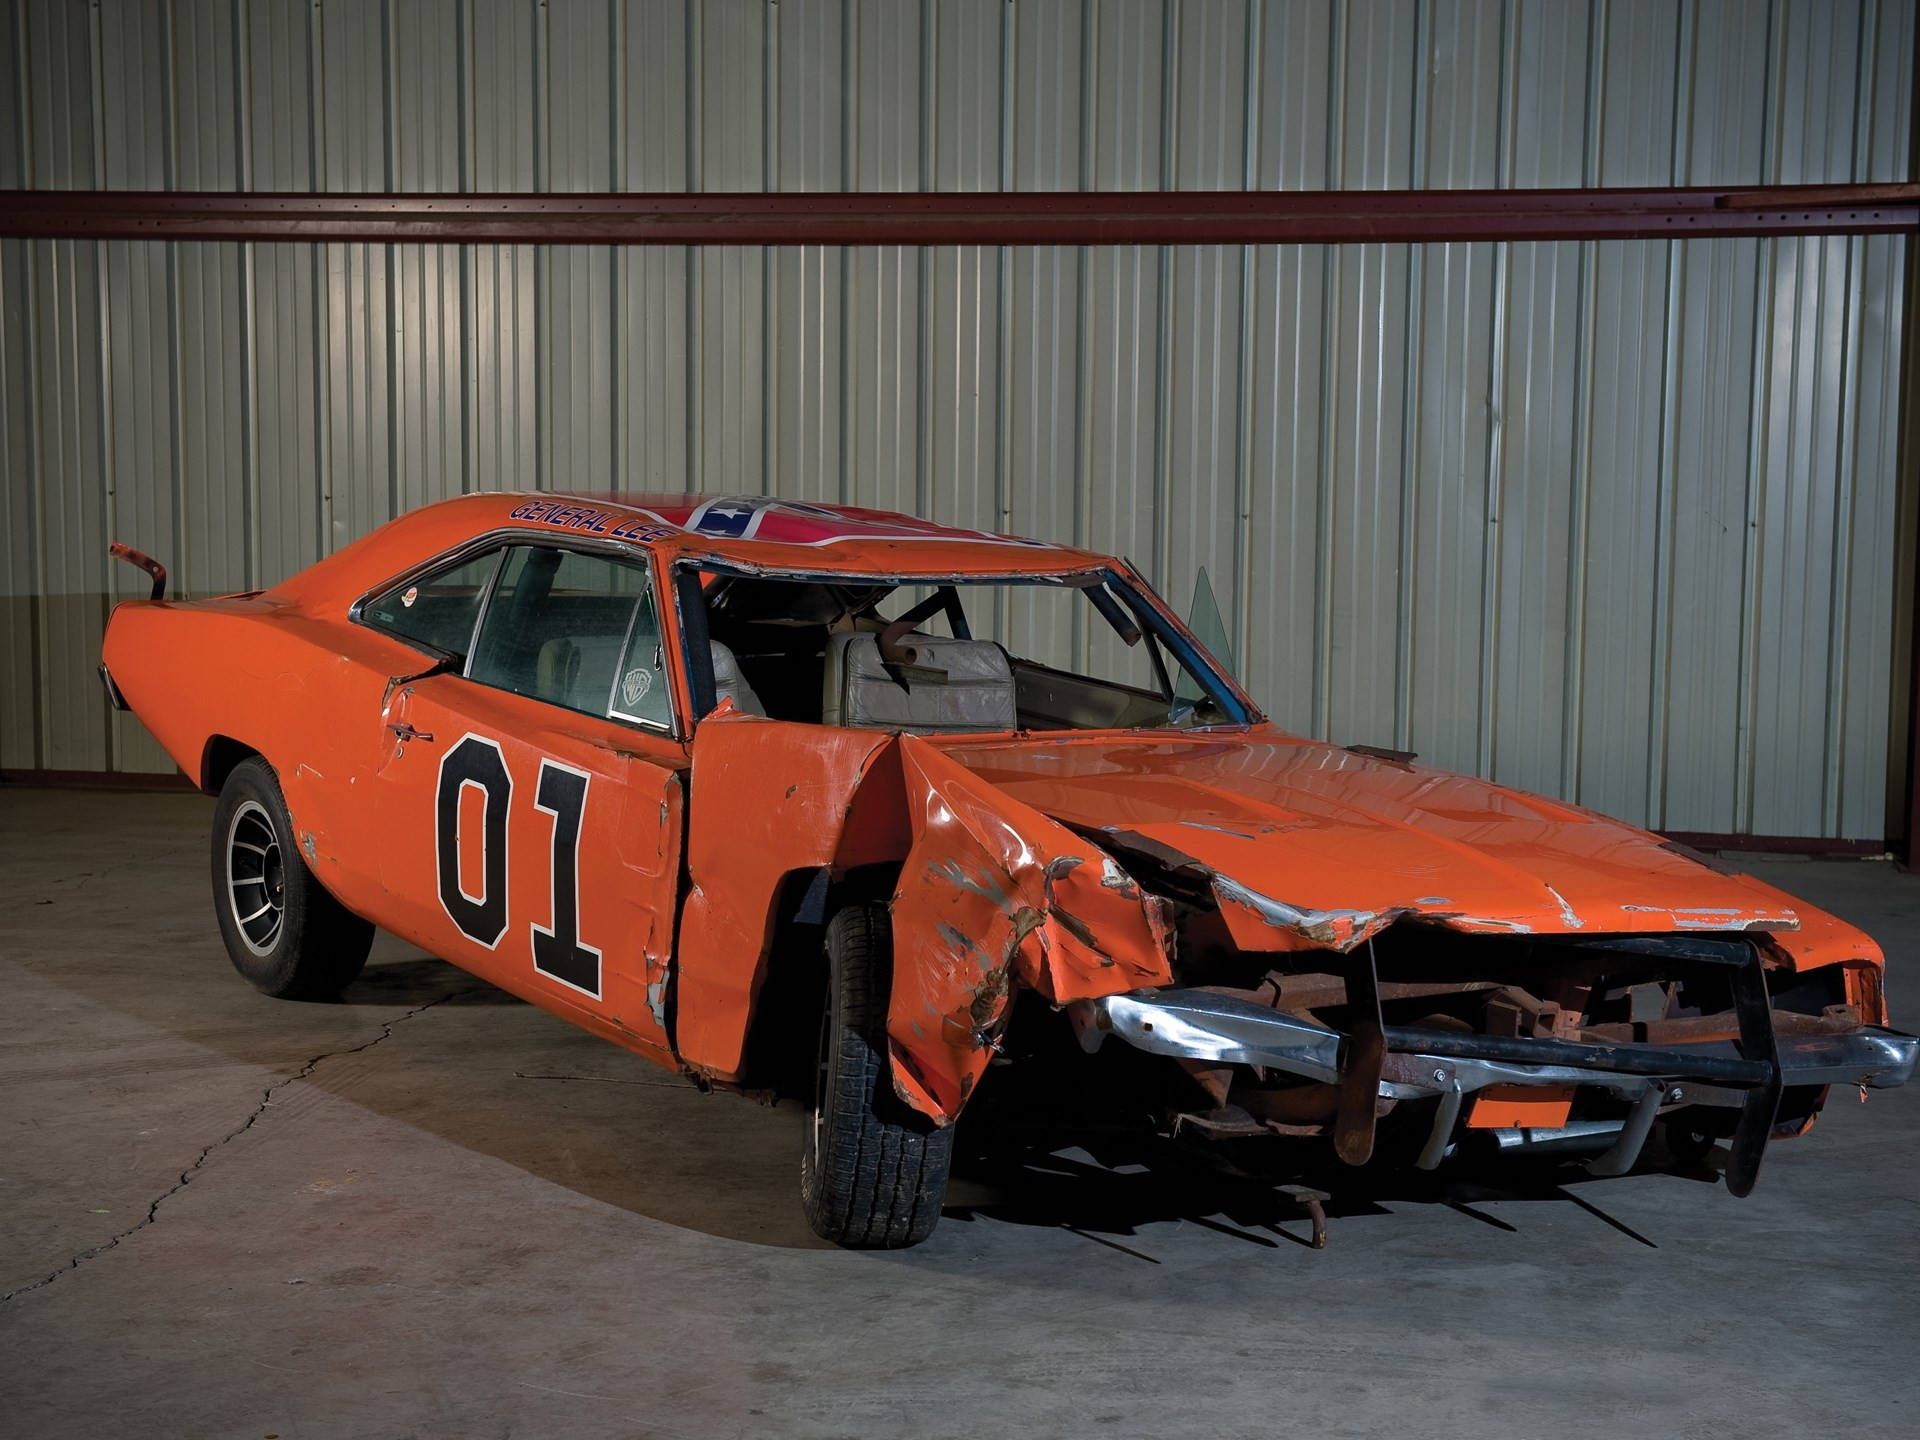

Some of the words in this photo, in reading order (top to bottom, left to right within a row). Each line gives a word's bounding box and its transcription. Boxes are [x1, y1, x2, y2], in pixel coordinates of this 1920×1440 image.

[509, 501, 615, 533] GENERAL
[610, 519, 679, 543] LEE
[436, 732, 603, 1001] 01
